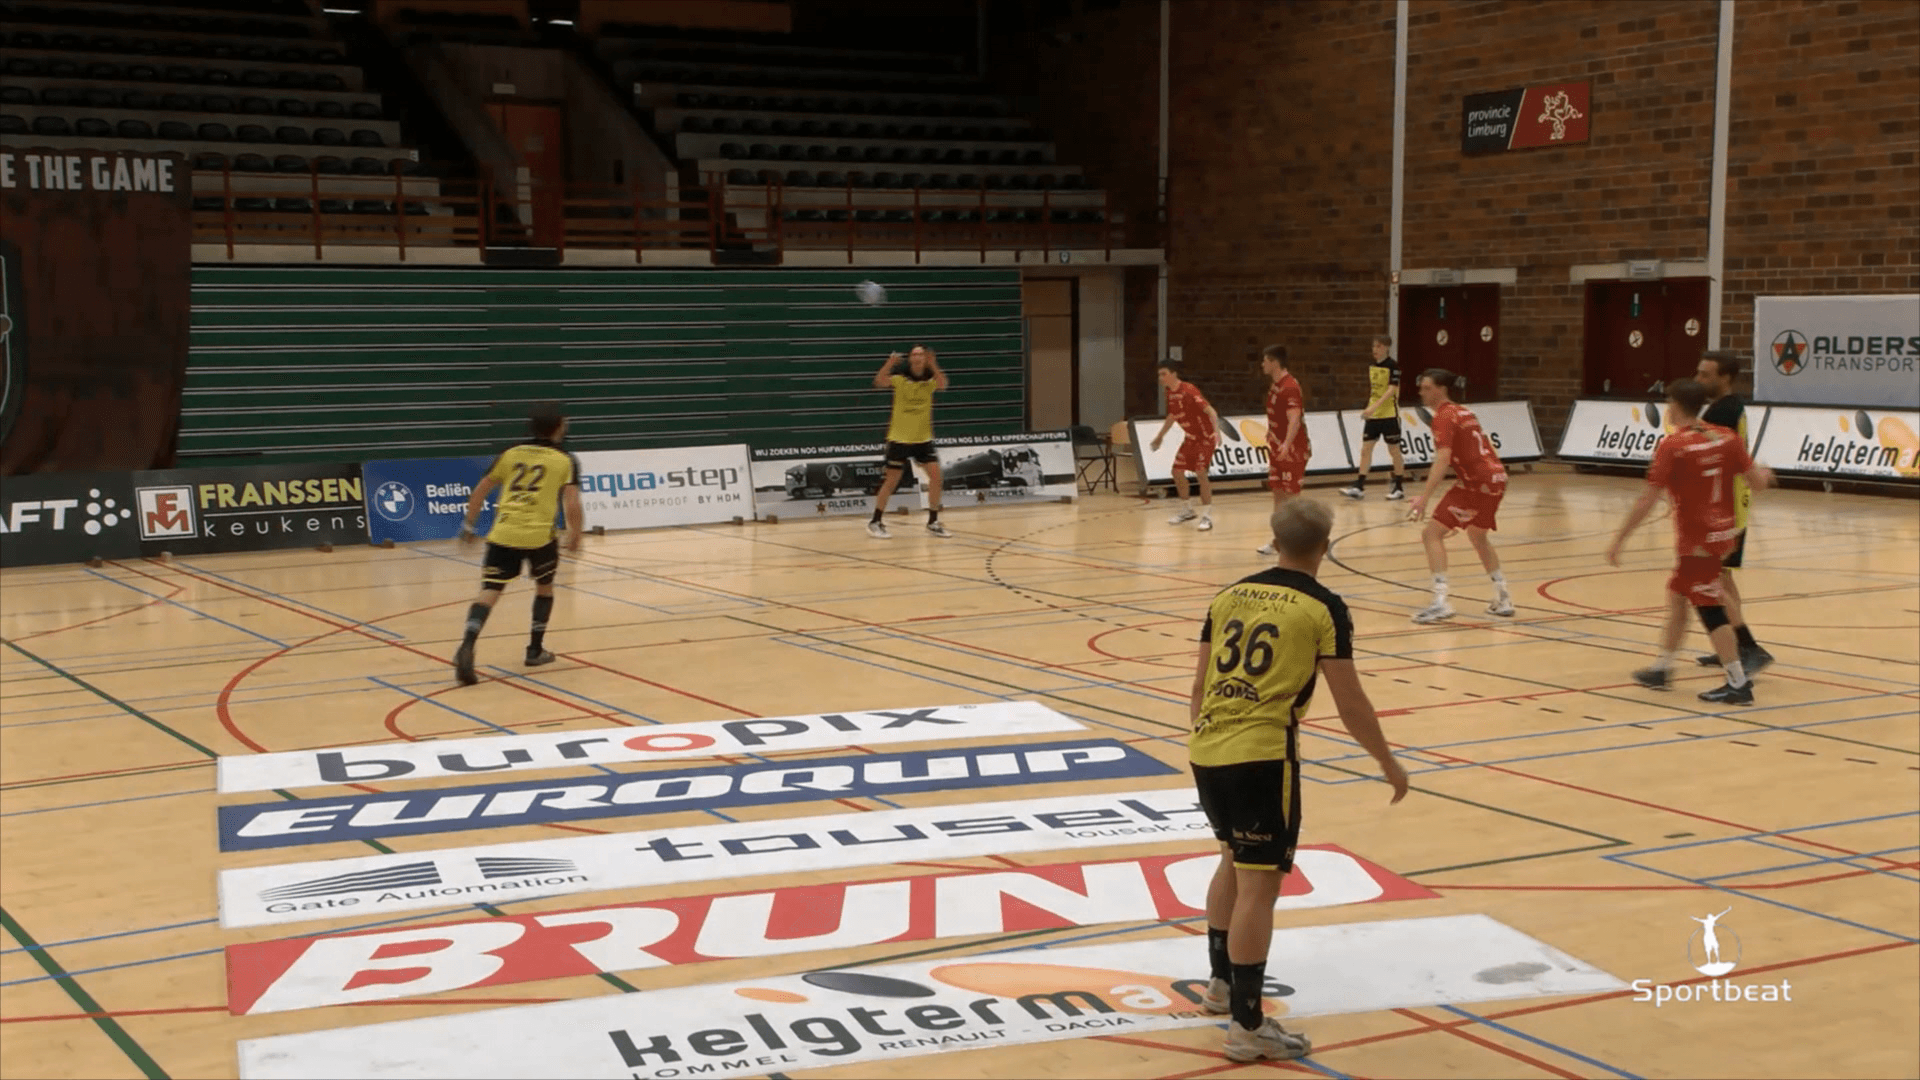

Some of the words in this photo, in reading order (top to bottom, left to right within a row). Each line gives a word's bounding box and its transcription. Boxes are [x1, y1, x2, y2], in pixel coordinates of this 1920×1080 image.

[1468, 105, 1511, 124] provincie
[1467, 123, 1507, 138] Limburg
[25, 155, 83, 190] THE
[90, 156, 174, 192] GAME
[1813, 336, 1919, 356] ALDERS
[1814, 357, 1919, 372] TRANSPOR
[769, 448, 799, 456] ZOEKEN
[800, 446, 817, 455] NOG
[930, 436, 958, 445] OEKEN
[958, 435, 973, 444] NOG
[992, 434, 1002, 442] EN
[1597, 424, 1665, 457] kelgter
[510, 462, 547, 492] 22
[667, 467, 738, 490] step
[199, 477, 363, 509] FRANSSEN
[613, 496, 689, 509] WATERPROOF
[698, 494, 712, 504] BY
[717, 493, 741, 503] HDM
[203, 515, 365, 537] keukens
[1230, 588, 1299, 604] HANDBAL
[1216, 619, 1280, 677] 36
[316, 708, 966, 783] buropix
[236, 746, 1126, 837] EUROQUIP
[265, 895, 361, 914] Gate
[376, 872, 588, 903] Automation
[257, 849, 1386, 1013] BRUNO
[878, 1029, 1006, 1051] RENAULT
[1044, 1016, 1134, 1032] DACIA
